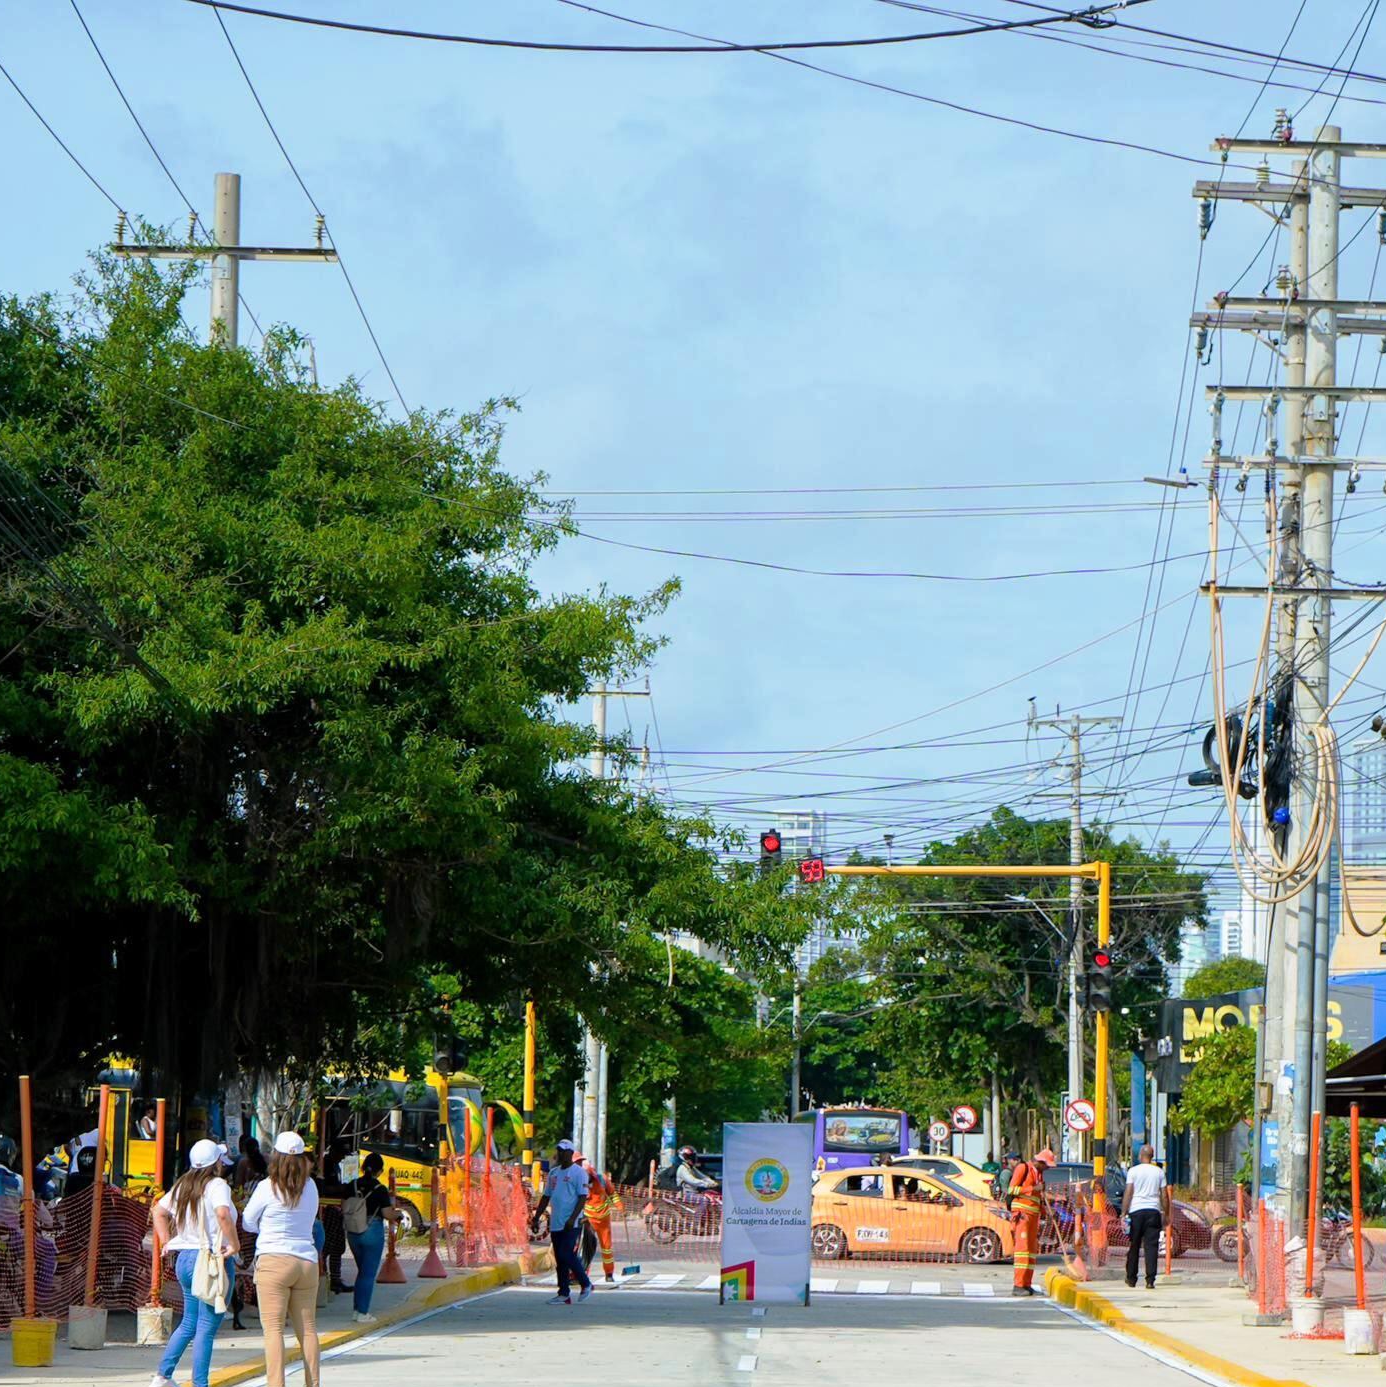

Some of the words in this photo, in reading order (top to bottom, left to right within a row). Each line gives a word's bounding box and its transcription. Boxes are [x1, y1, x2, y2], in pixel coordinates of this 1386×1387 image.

[933, 1126, 945, 1137] 30
[765, 1207, 791, 1217] Mayor
[792, 1207, 802, 1216] de
[726, 1217, 768, 1226] Cartagena
[769, 1217, 779, 1226] de
[780, 1217, 806, 1226] Indias
